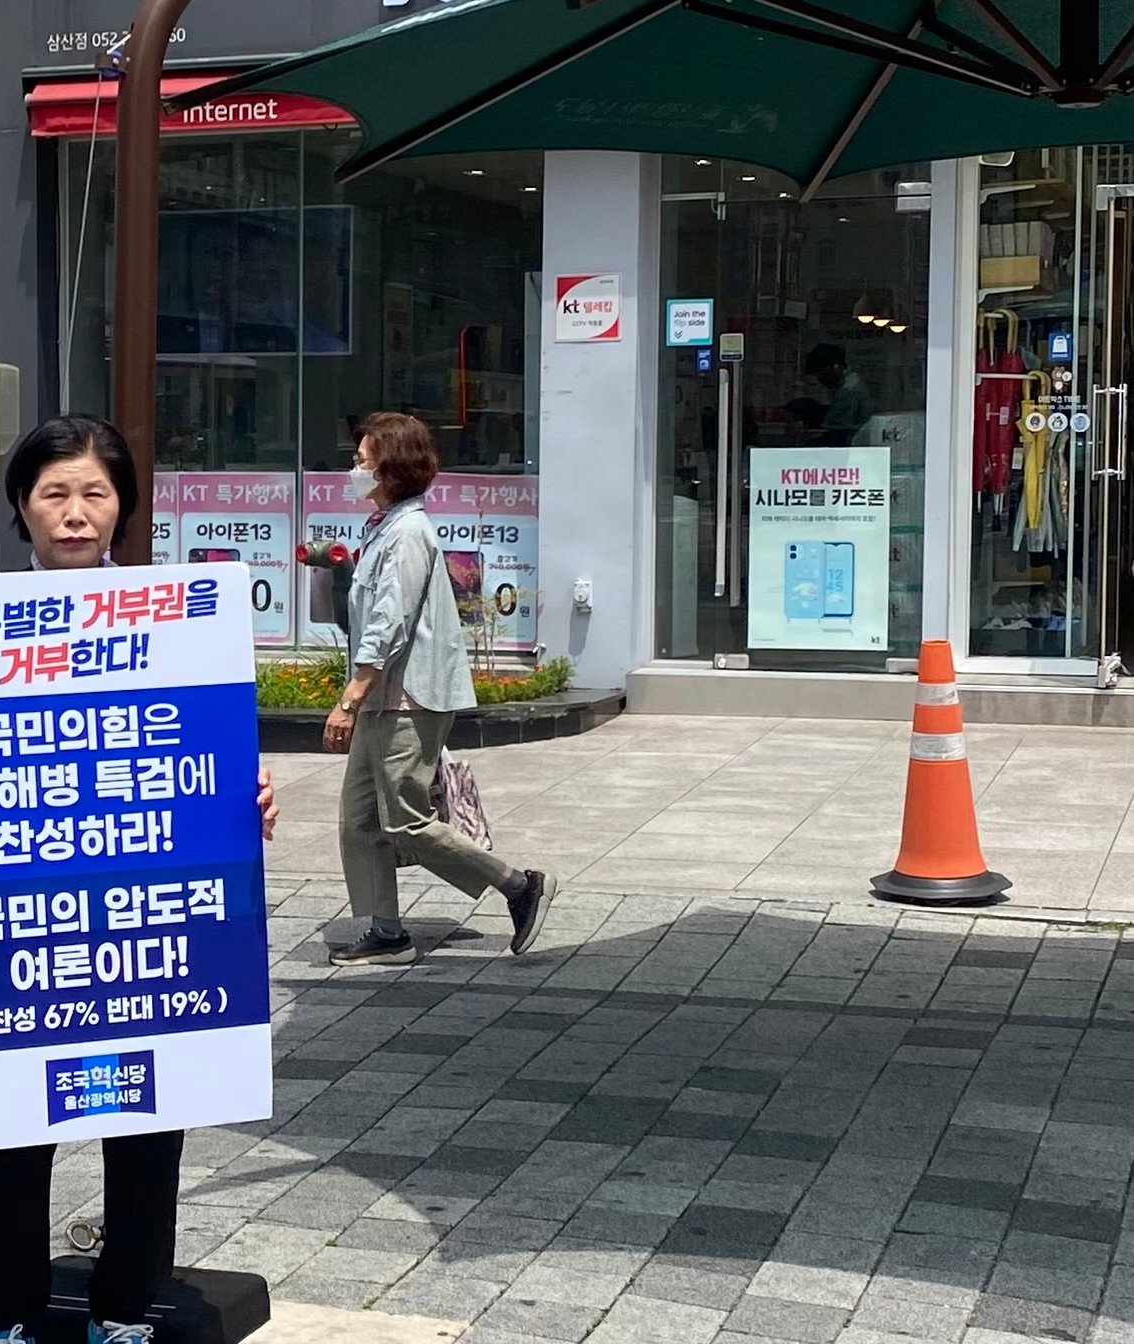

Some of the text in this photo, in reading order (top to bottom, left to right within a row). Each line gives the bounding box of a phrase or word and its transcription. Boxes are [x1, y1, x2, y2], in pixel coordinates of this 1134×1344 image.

[47, 33, 88, 52] 삼산점
[183, 99, 278, 124] internet
[563, 299, 580, 314] kt
[692, 310, 706, 318] the
[781, 467, 860, 486] KT에서만!
[183, 485, 209, 502] KT
[216, 484, 290, 505] 특가행사
[309, 484, 336, 502] KT
[424, 484, 537, 506] KT 특가행사
[831, 489, 885, 507] 키즈폰
[196, 522, 272, 543] 아이폰13
[309, 524, 353, 541] 갤럭시
[437, 524, 519, 545] 아이폰13
[82, 578, 219, 630] 거부권을
[0, 633, 149, 686] 거부한다!
[94, 753, 216, 802] 특검에
[104, 878, 226, 930] 압도적
[10, 935, 189, 991] 여론이다!
[44, 1000, 100, 1030] 67%
[107, 994, 154, 1023] 반대
[55, 1064, 147, 1092] 조국혁신당
[64, 1088, 142, 1111] 울산광역시당
